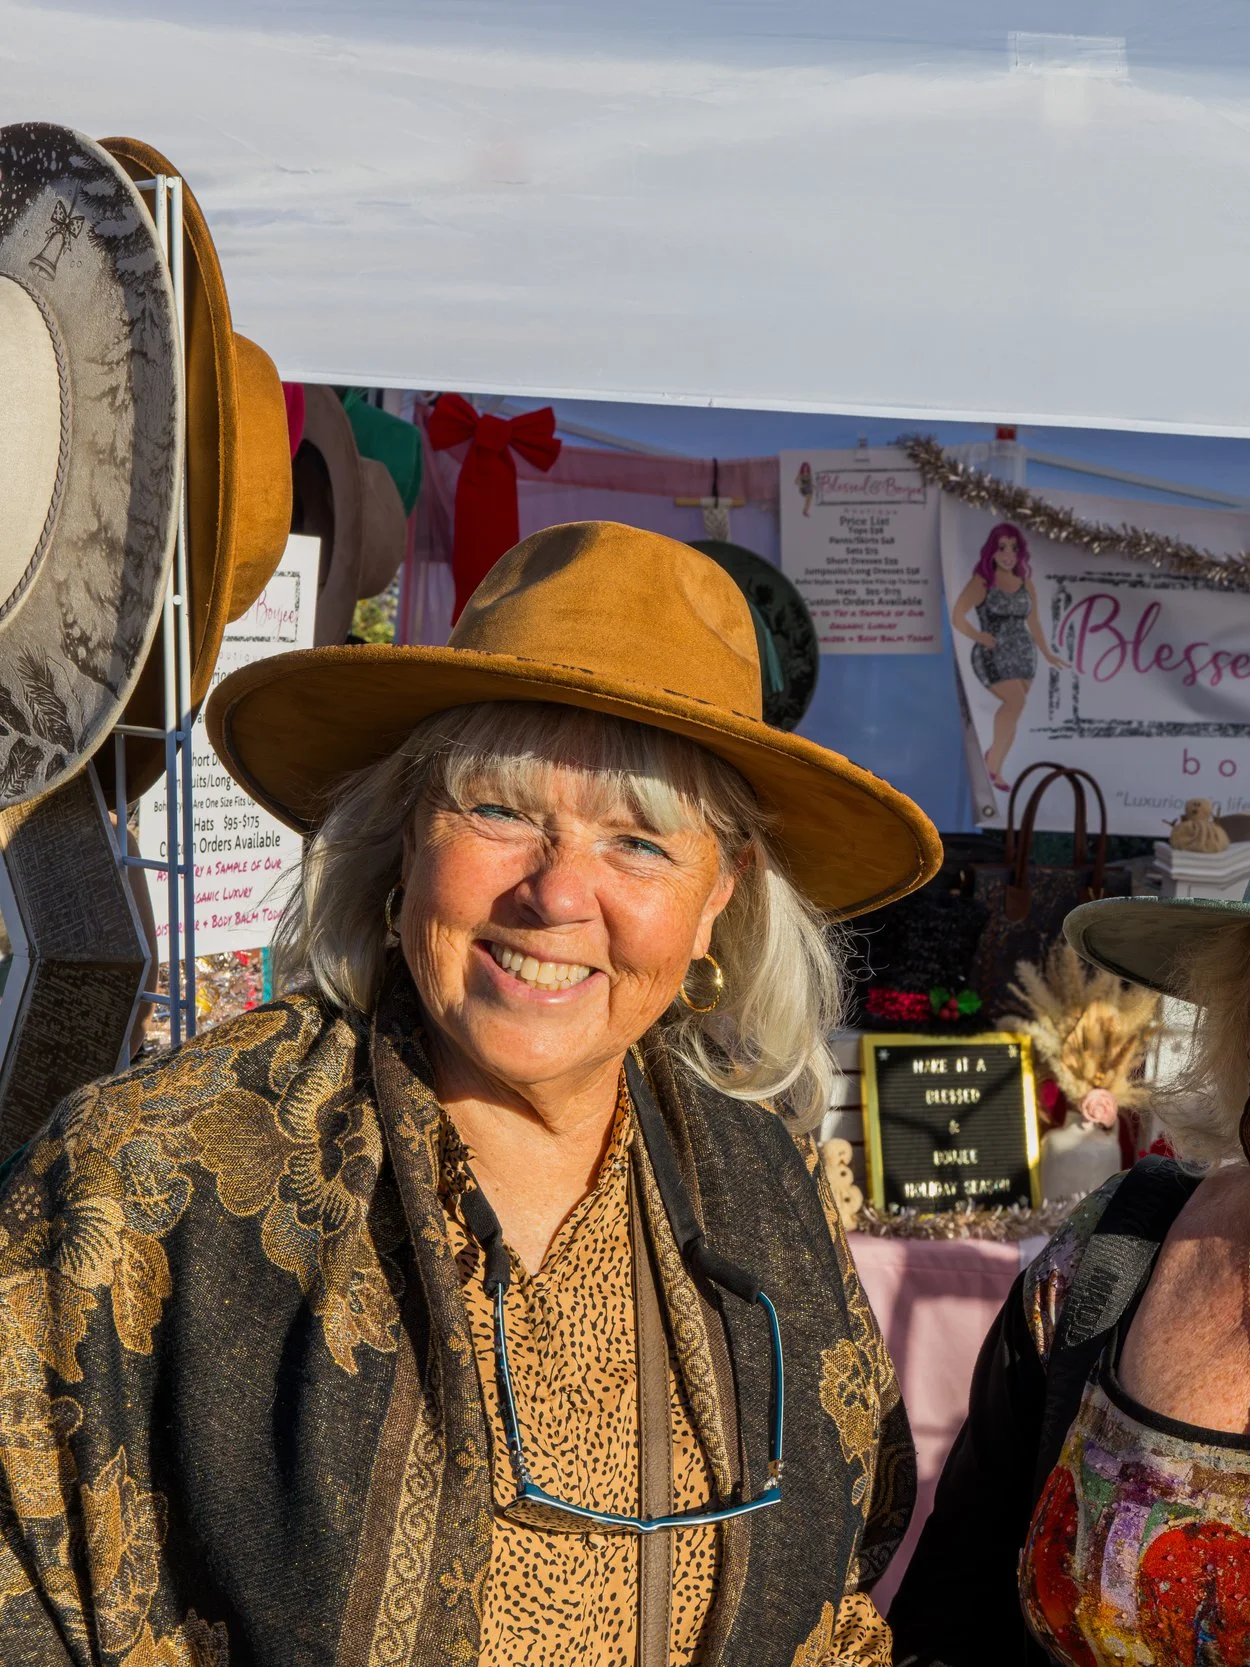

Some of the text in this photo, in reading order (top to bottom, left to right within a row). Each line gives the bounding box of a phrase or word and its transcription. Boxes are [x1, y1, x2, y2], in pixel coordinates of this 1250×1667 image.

[840, 516, 890, 526] Price List
[842, 596, 875, 606] Orders
[877, 595, 922, 606] Available
[256, 589, 296, 636] Boujee
[205, 798, 219, 809] One
[220, 796, 233, 807] Size
[235, 795, 246, 806] Fits
[194, 813, 260, 832] Hats $95-$175
[199, 834, 232, 854] Orders
[234, 830, 281, 851] Available
[913, 1057, 987, 1074] MAKE IT A
[925, 1088, 981, 1105] BLESSED
[933, 1149, 979, 1166] BOUJEE
[904, 1180, 957, 1198] HOLIDAY
